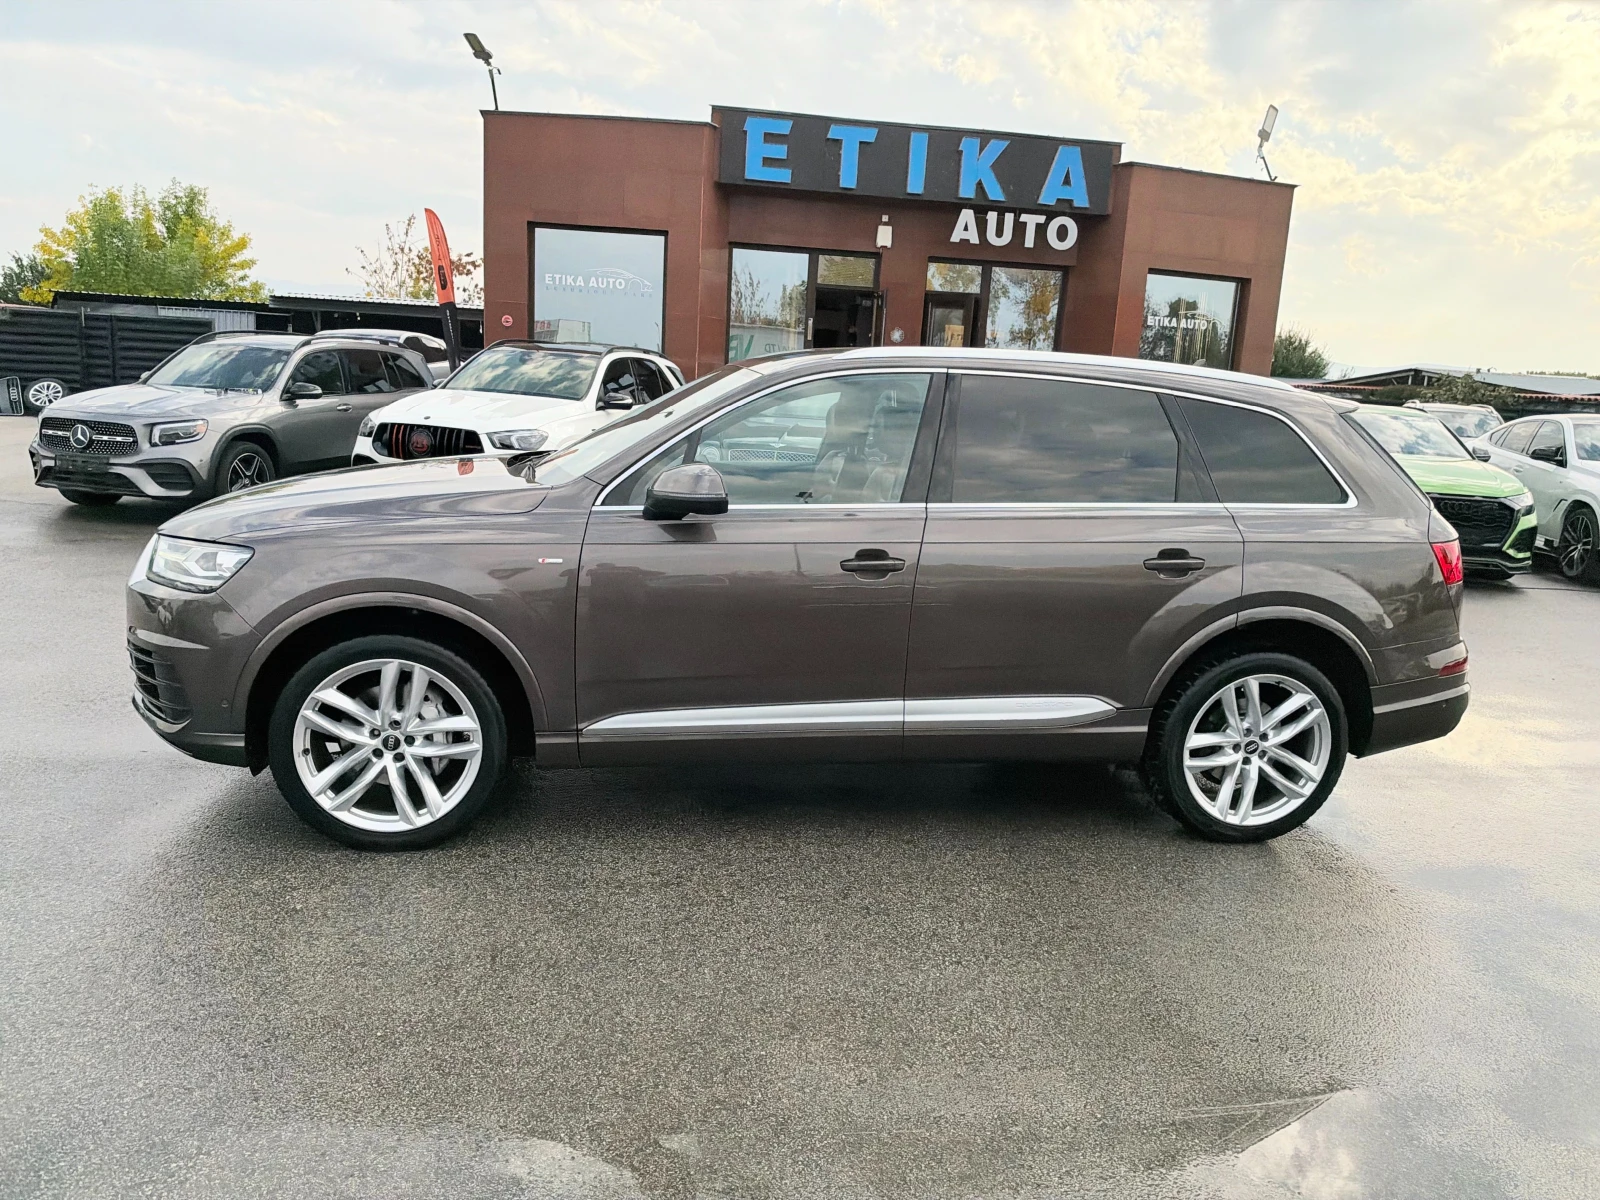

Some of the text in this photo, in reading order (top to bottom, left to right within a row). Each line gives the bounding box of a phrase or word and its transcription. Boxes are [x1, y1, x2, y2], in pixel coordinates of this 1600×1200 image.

[743, 116, 1091, 208] ETIKA
[949, 208, 1079, 251] AUTO
[545, 273, 626, 290] ETIKA AUTO
[1147, 315, 1208, 330] ETIKA AUTO
